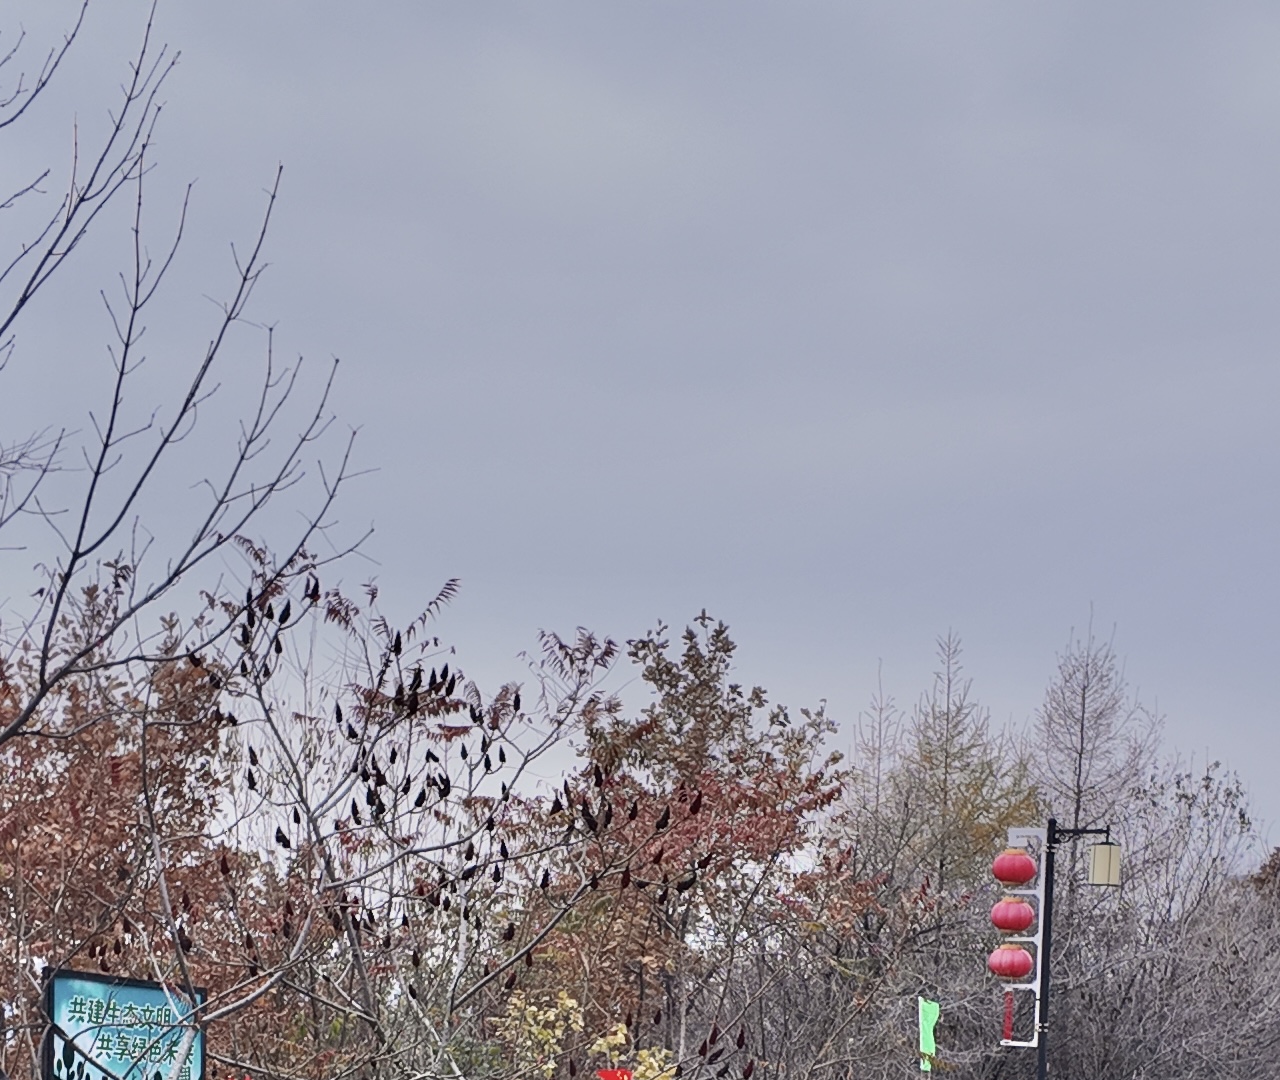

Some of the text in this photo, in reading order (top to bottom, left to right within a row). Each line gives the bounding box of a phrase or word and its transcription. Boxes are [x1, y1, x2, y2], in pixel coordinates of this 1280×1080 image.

[67, 996, 172, 1030] 共建生态文明
